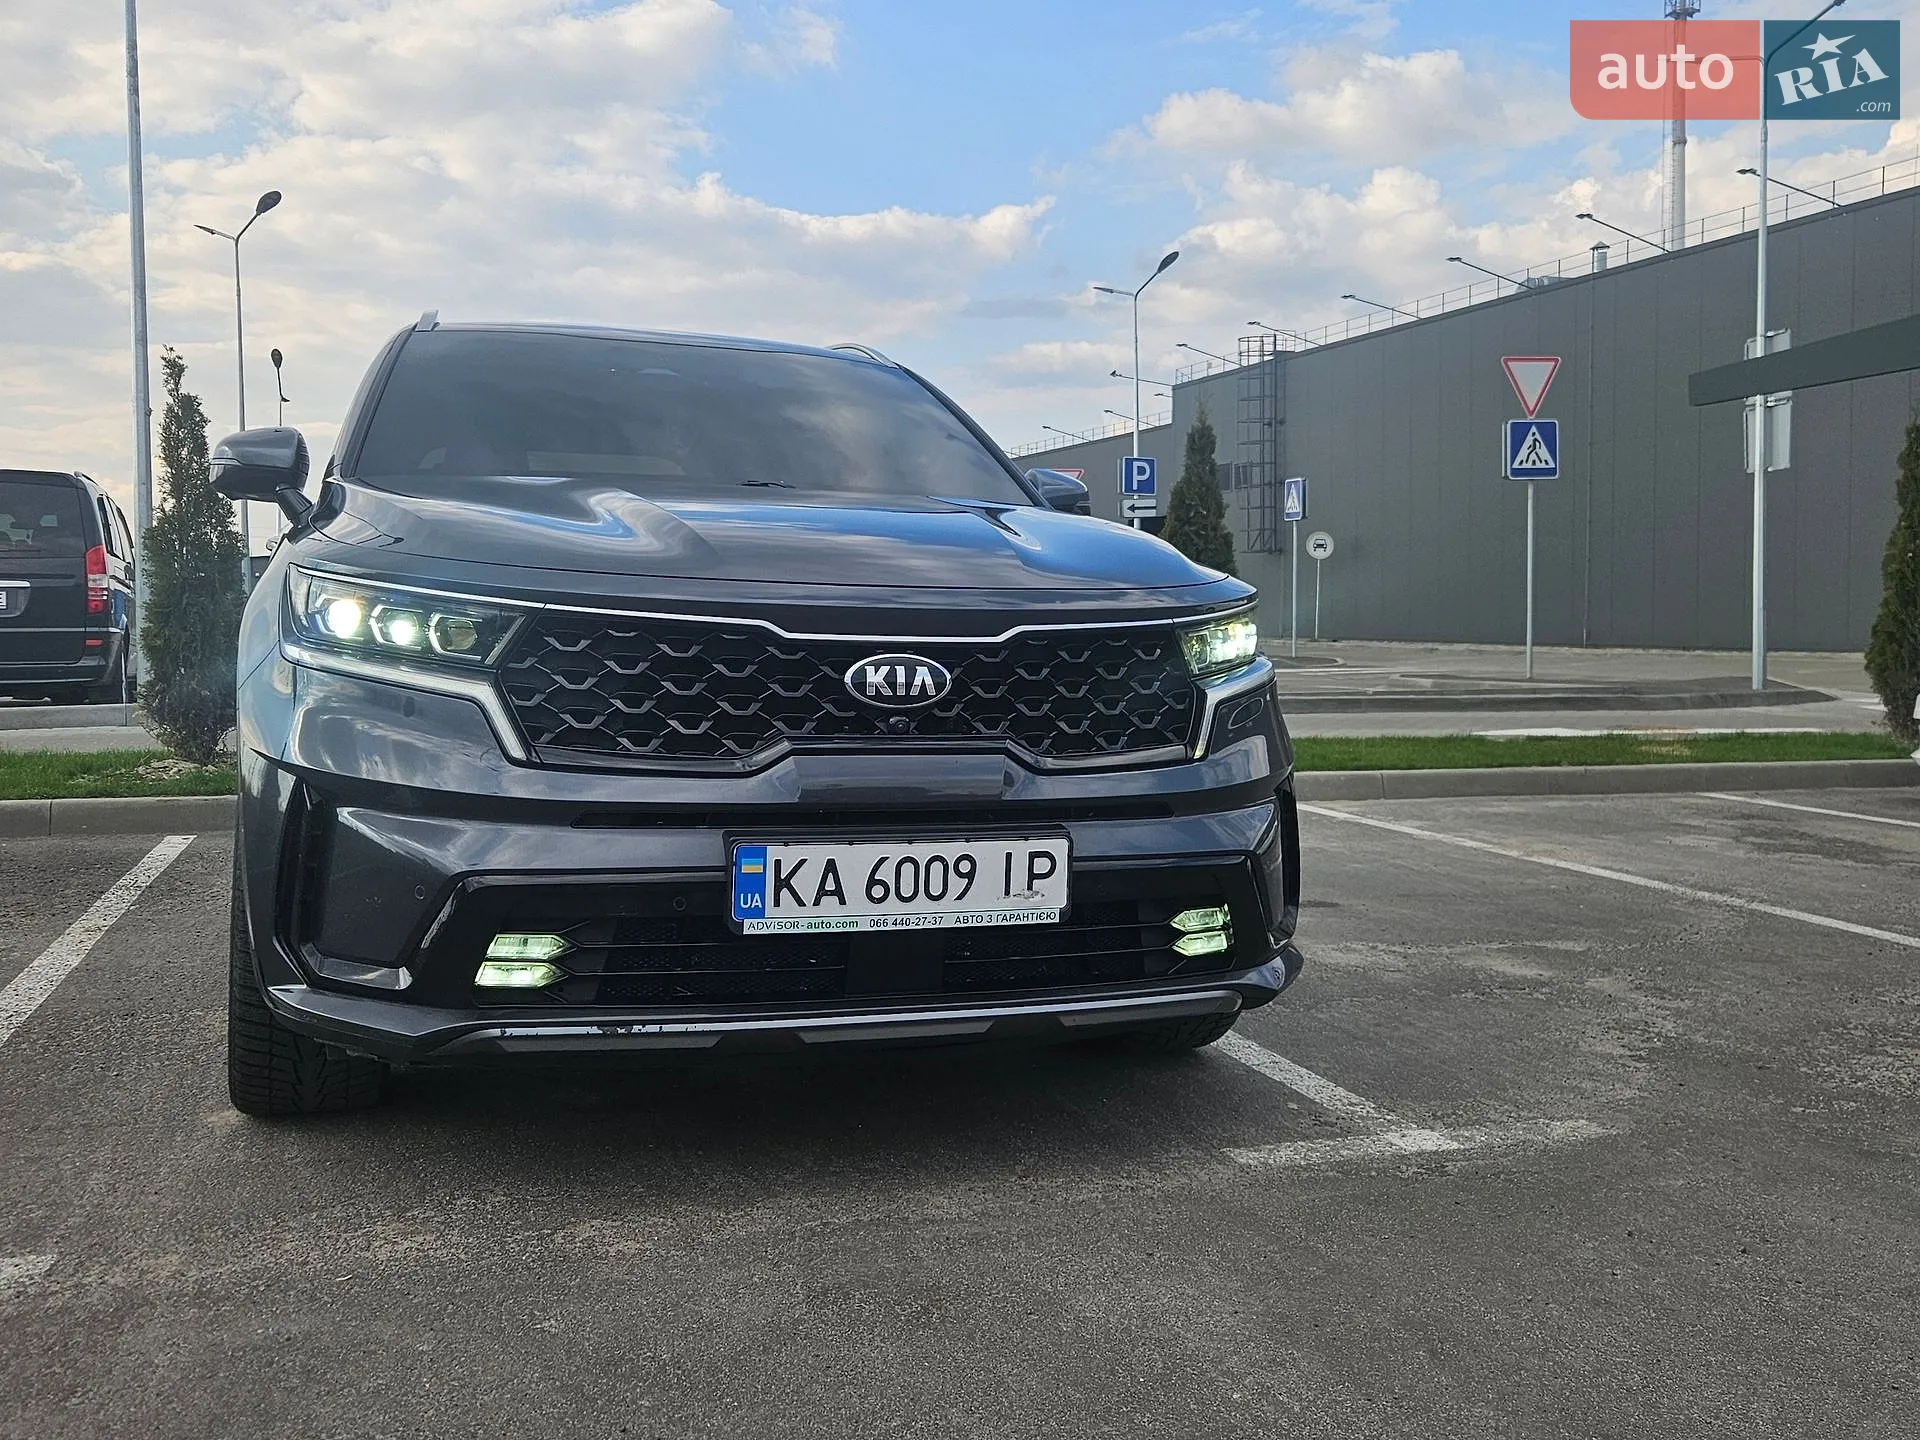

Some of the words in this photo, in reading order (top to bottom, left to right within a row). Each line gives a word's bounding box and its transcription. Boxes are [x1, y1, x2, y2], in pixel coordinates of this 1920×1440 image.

[1132, 461, 1151, 490] P
[864, 665, 936, 696] KIA
[772, 857, 847, 908] KA
[864, 853, 977, 905] 6009
[1003, 850, 1058, 898] IP
[740, 893, 763, 909] UA
[869, 918, 889, 928] 066
[891, 916, 944, 927] 440-27-37
[954, 914, 984, 925] АВТО
[996, 911, 1057, 923] ГАРАНТІЄЮ
